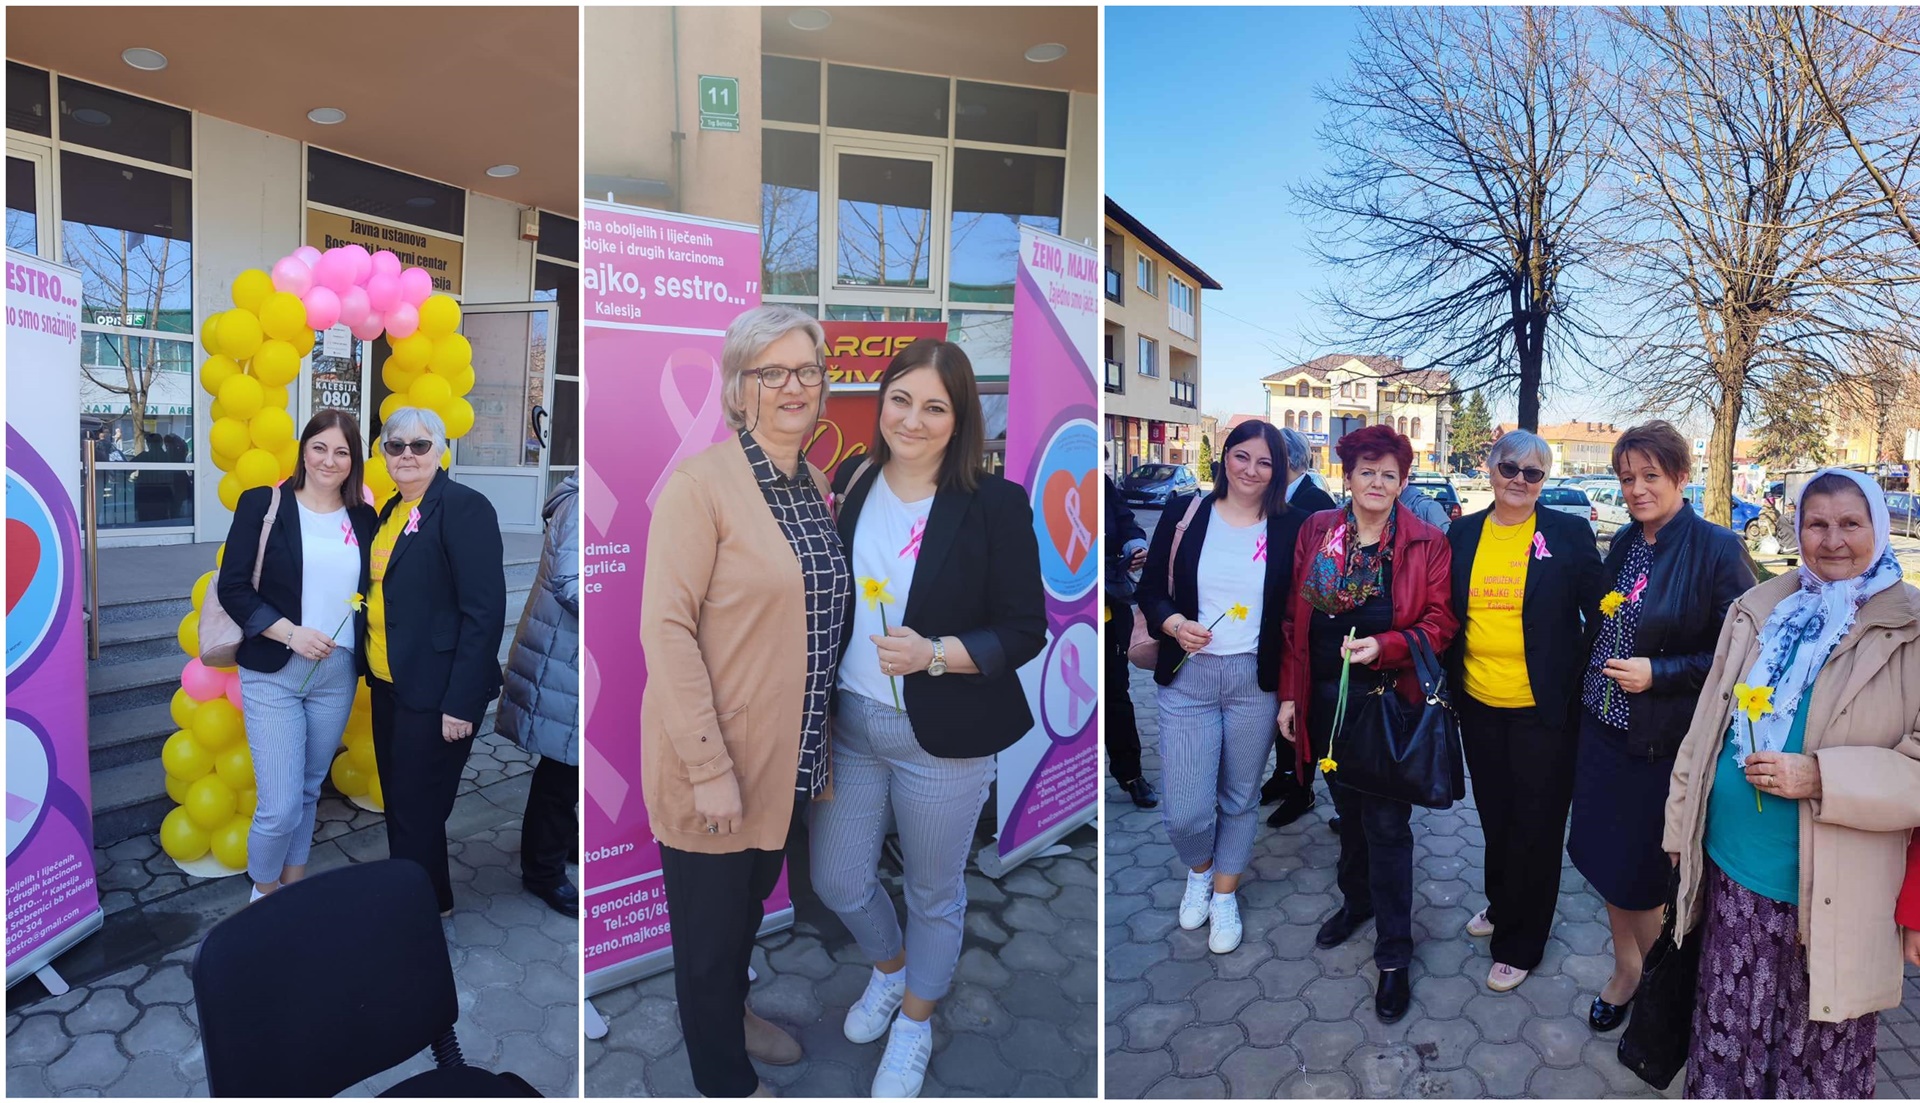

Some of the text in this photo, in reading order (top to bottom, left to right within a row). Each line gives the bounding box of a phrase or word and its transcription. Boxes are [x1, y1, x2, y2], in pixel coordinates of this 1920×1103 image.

[708, 87, 728, 106] 11
[350, 219, 427, 248] Javna ustanova
[605, 221, 657, 239] oboljelih
[660, 227, 664, 240] i
[667, 229, 713, 247] liječenih
[417, 255, 448, 271] centar
[584, 238, 724, 267] dojke i drugih karcinoma
[1032, 236, 1064, 279] ŽENO,
[595, 301, 642, 319] Kalesija
[18, 308, 39, 331] smo
[41, 312, 77, 345] snažnije
[315, 382, 358, 393] KALESIJA
[322, 390, 351, 406] 080
[585, 542, 630, 556] dmica
[584, 560, 626, 577] grlića
[585, 582, 603, 593] ce
[584, 843, 634, 863] tobar»
[42, 854, 75, 876] liječenih
[13, 884, 41, 905] drugih
[42, 861, 82, 887] karcinoma
[50, 874, 80, 897] Kalesija
[10, 902, 52, 931] Srebrenici
[54, 893, 64, 906] bb
[65, 877, 94, 899] Kalesija
[591, 890, 649, 918] genocida
[651, 888, 659, 898] u
[6, 908, 80, 957] sestro@gmail.com
